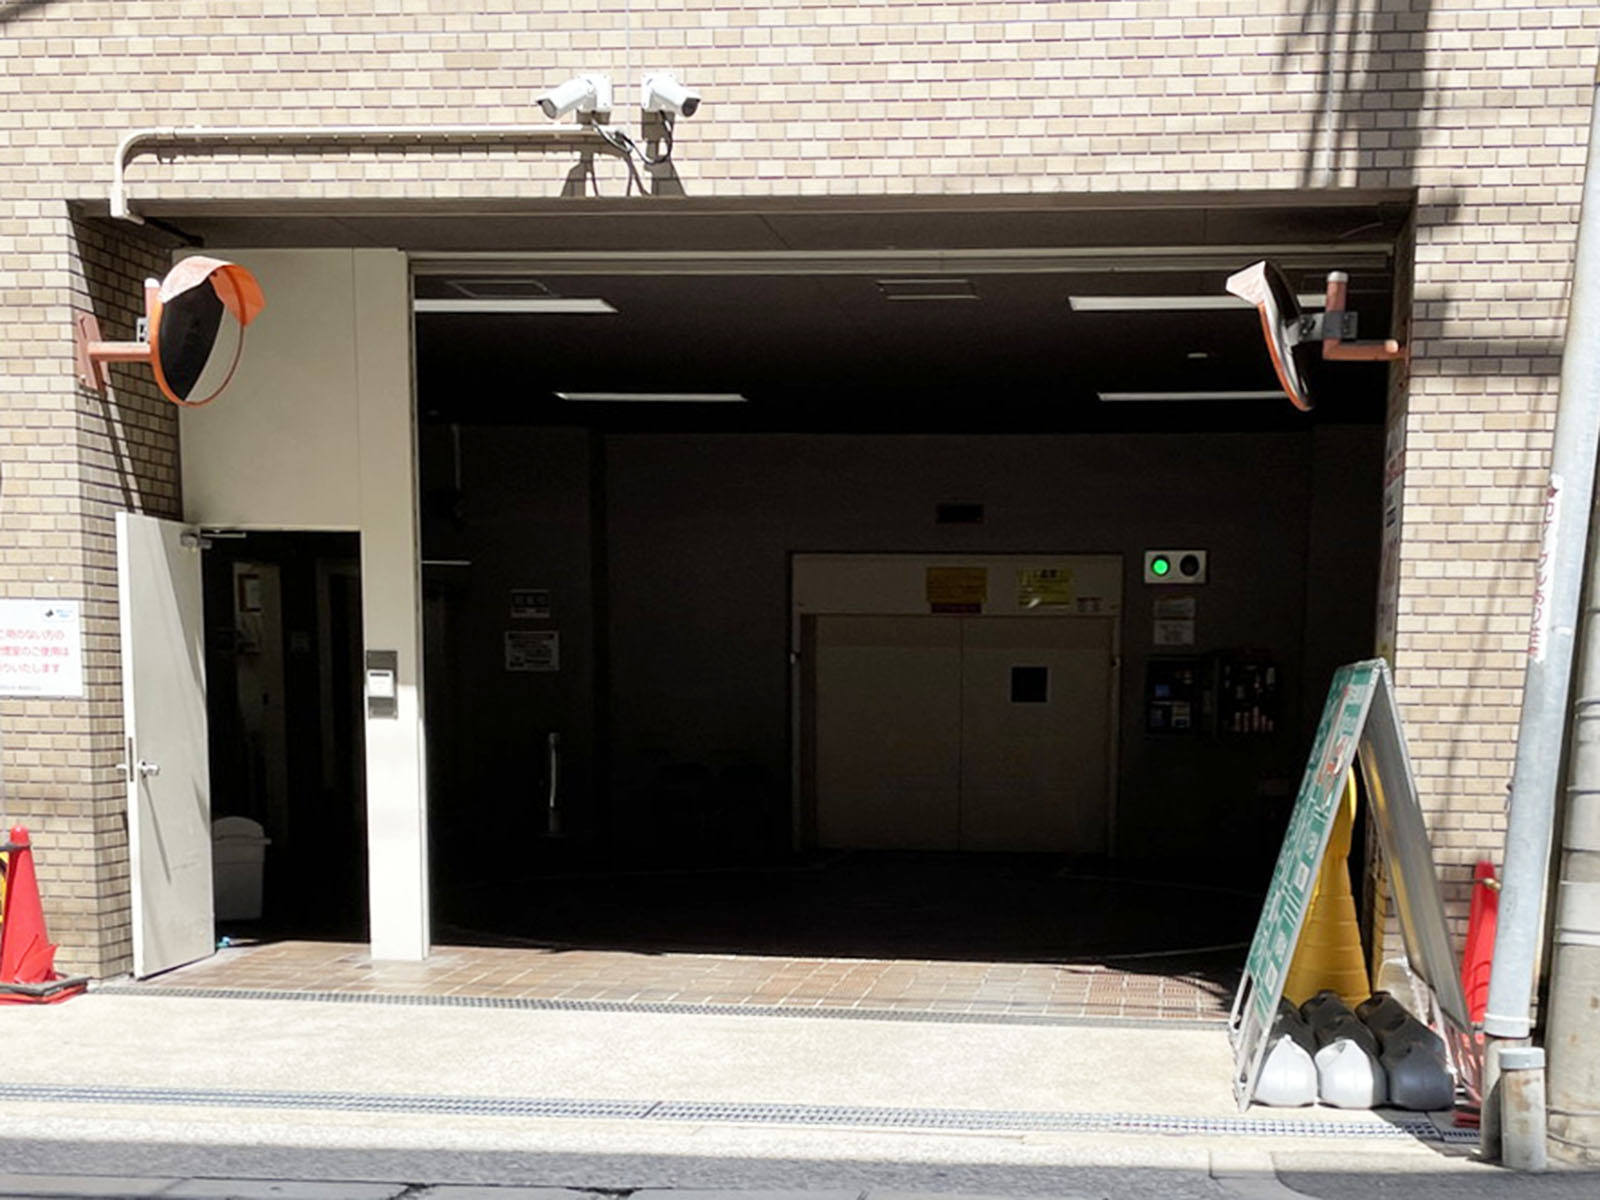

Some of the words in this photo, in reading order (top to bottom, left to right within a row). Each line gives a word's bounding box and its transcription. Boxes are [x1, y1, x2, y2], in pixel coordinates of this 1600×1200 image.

[0, 646, 69, 656] 煙室のご使用は
[0, 663, 60, 673] りいたします
